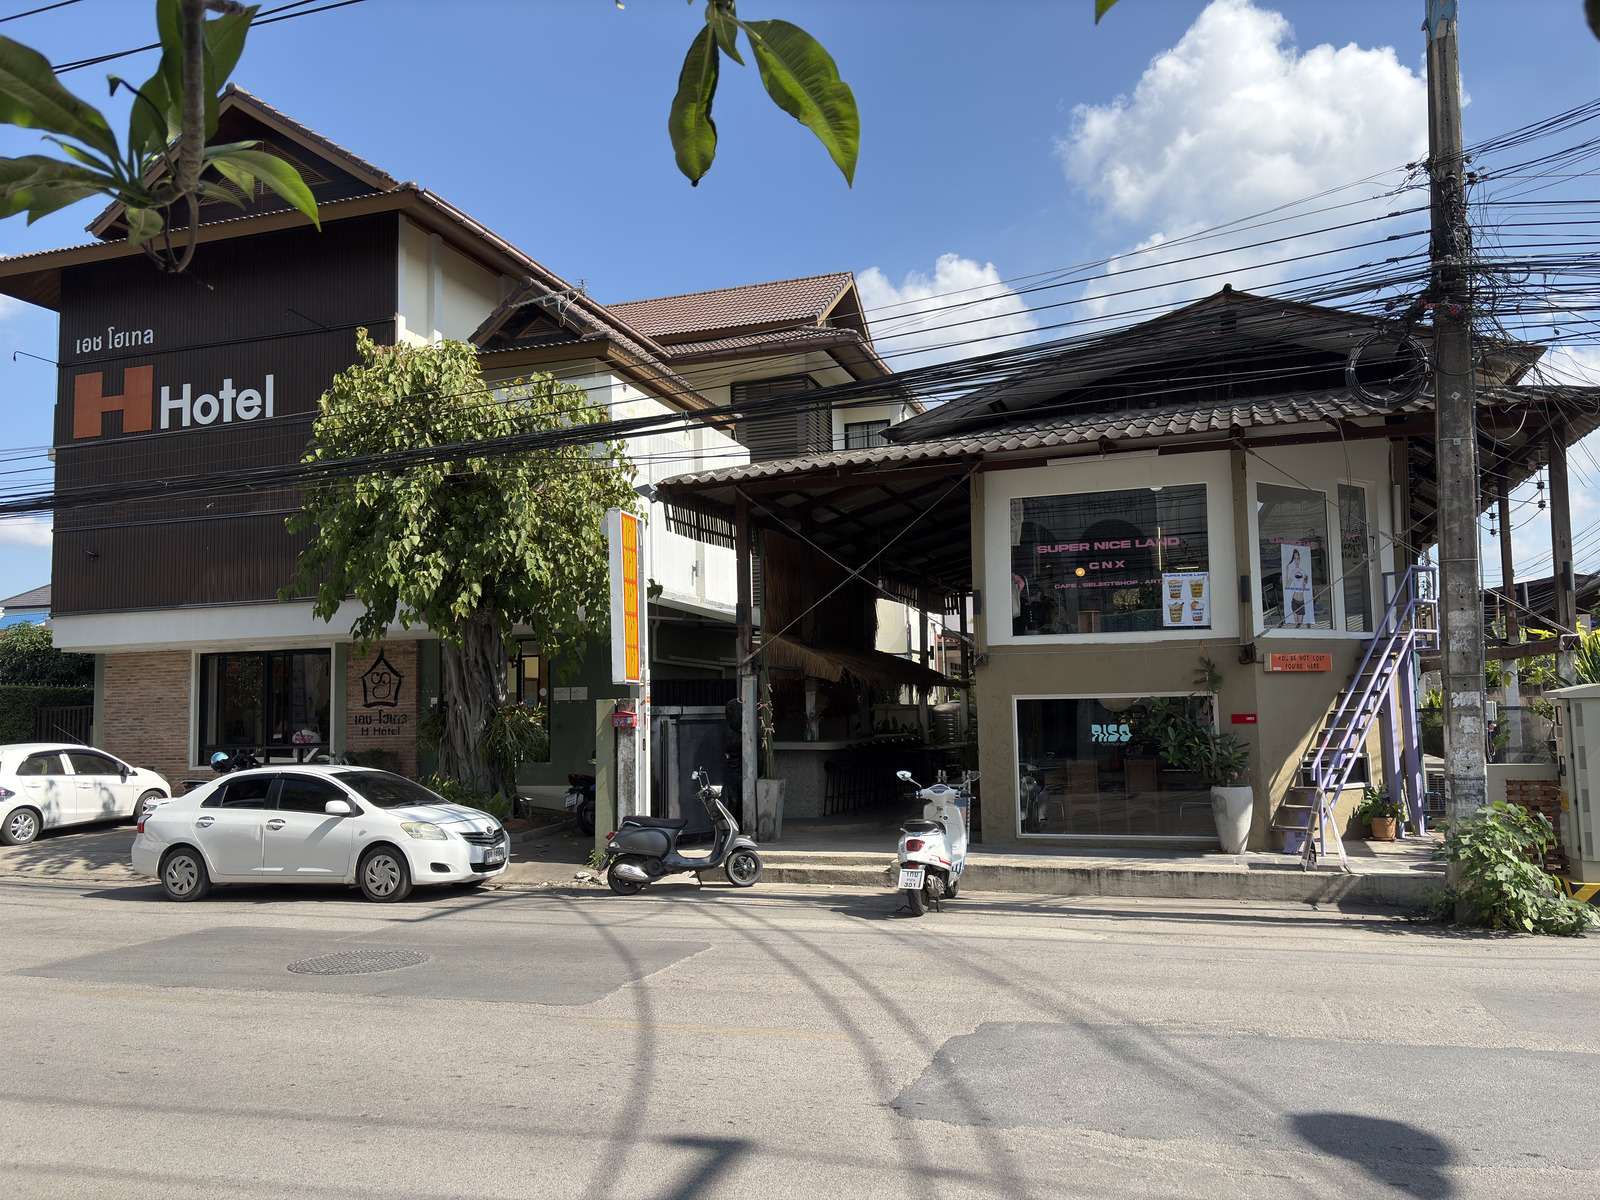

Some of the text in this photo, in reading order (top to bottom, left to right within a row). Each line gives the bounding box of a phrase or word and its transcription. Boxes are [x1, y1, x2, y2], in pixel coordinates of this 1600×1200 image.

[75, 326, 154, 354] เอช โฮเทล
[73, 365, 274, 439] H Hotel
[1036, 537, 1180, 554] SUPER NICE LAND
[1082, 580, 1138, 588] SELECTSHOP
[361, 727, 400, 736] H Hotel
